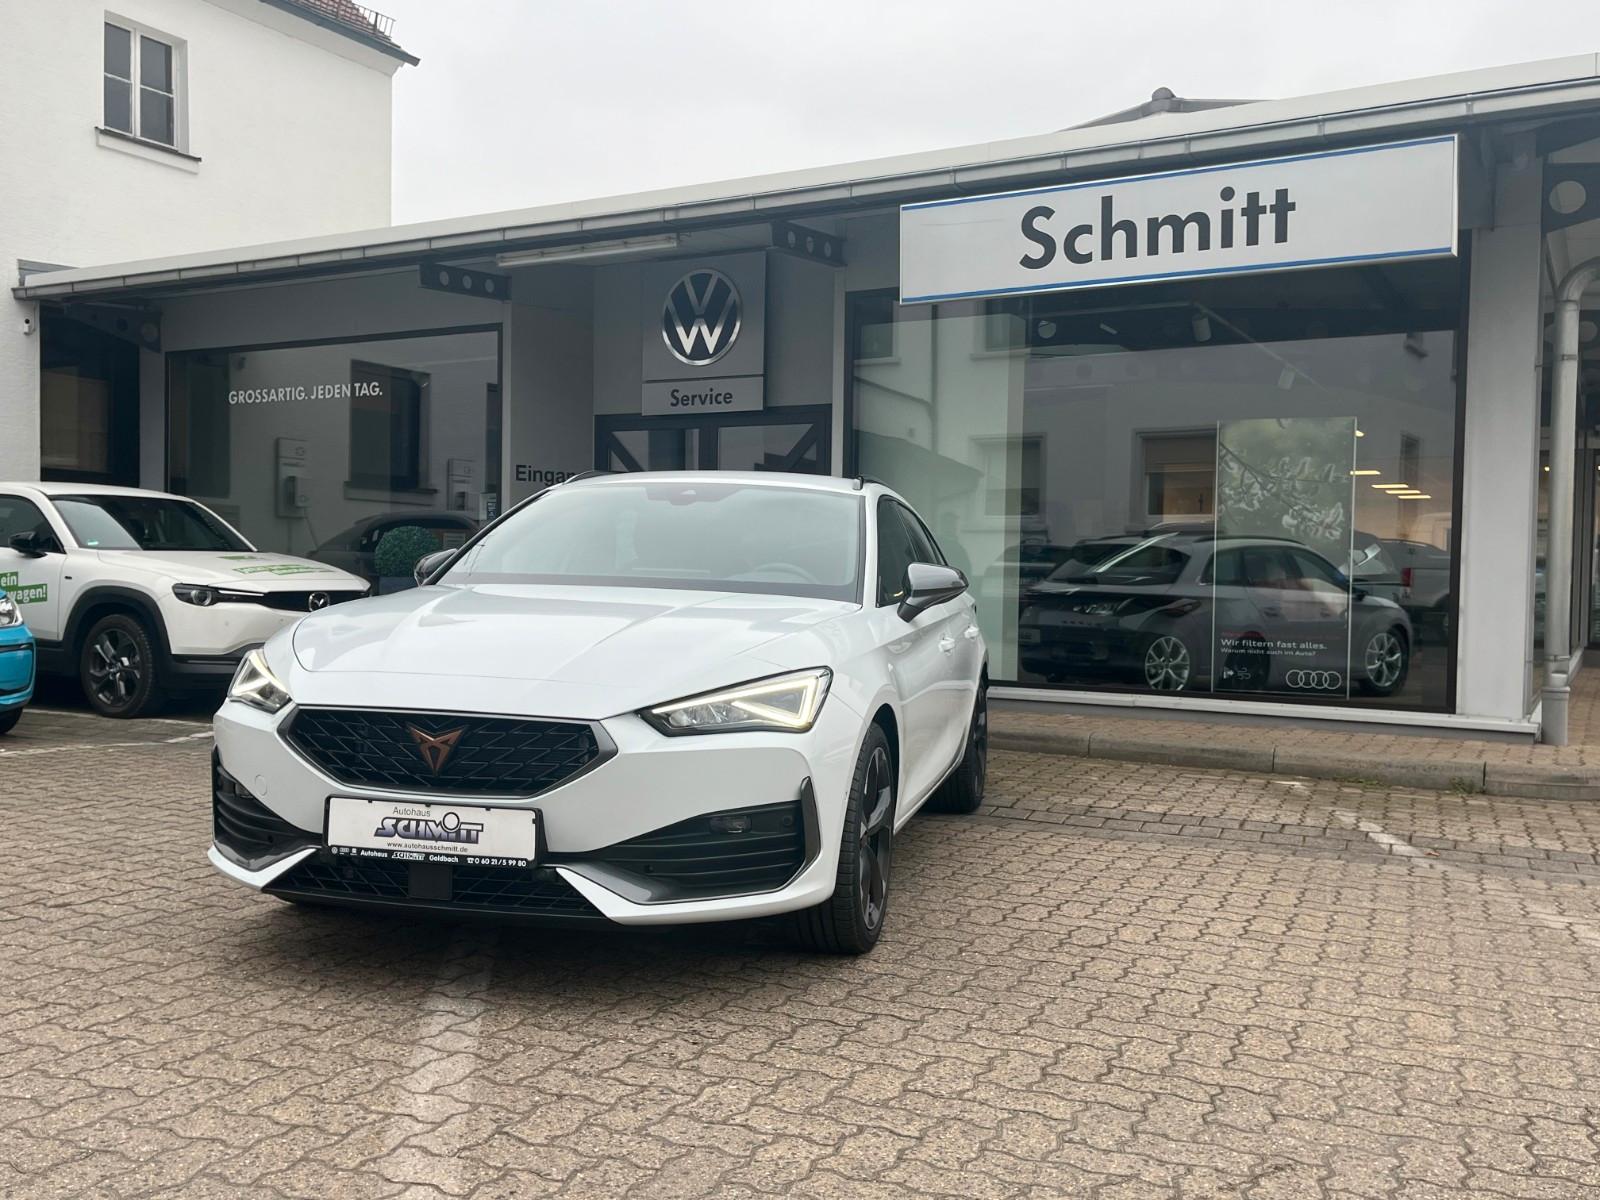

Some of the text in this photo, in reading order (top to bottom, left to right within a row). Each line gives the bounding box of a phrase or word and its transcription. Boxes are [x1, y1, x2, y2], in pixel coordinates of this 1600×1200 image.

[1019, 186, 1297, 270] Schmitt
[228, 381, 383, 405] GROSSARTIG. JEDEN TAG.
[670, 387, 733, 408] Service
[1220, 639, 1328, 650] Wir filtern fast alles.
[392, 806, 431, 817] Autohaus
[374, 812, 484, 844] SCHMITT
[387, 841, 468, 853] www.autohausschmitt.de
[360, 849, 388, 858] Autohaus
[429, 854, 459, 863] Goldbach
